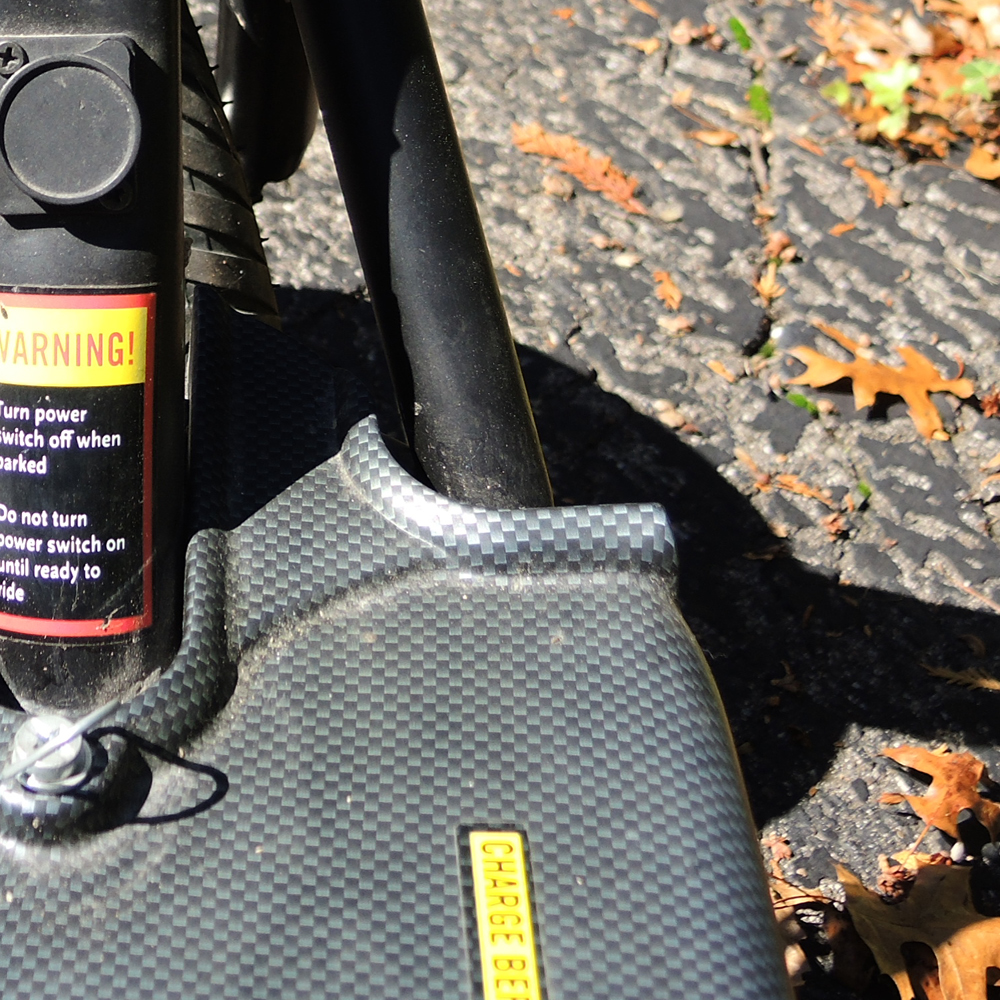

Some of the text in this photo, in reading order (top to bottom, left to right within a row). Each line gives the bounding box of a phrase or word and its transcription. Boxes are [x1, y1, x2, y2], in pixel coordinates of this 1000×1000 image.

[34, 406, 88, 426] power
[49, 429, 75, 448] off
[76, 429, 121, 448] when
[21, 510, 48, 527] not
[52, 511, 88, 527] turn
[47, 534, 101, 553] switch
[105, 537, 125, 551] on
[34, 561, 79, 585] ready
[84, 563, 101, 579] to
[481, 843, 530, 1000] CHARGE BE
